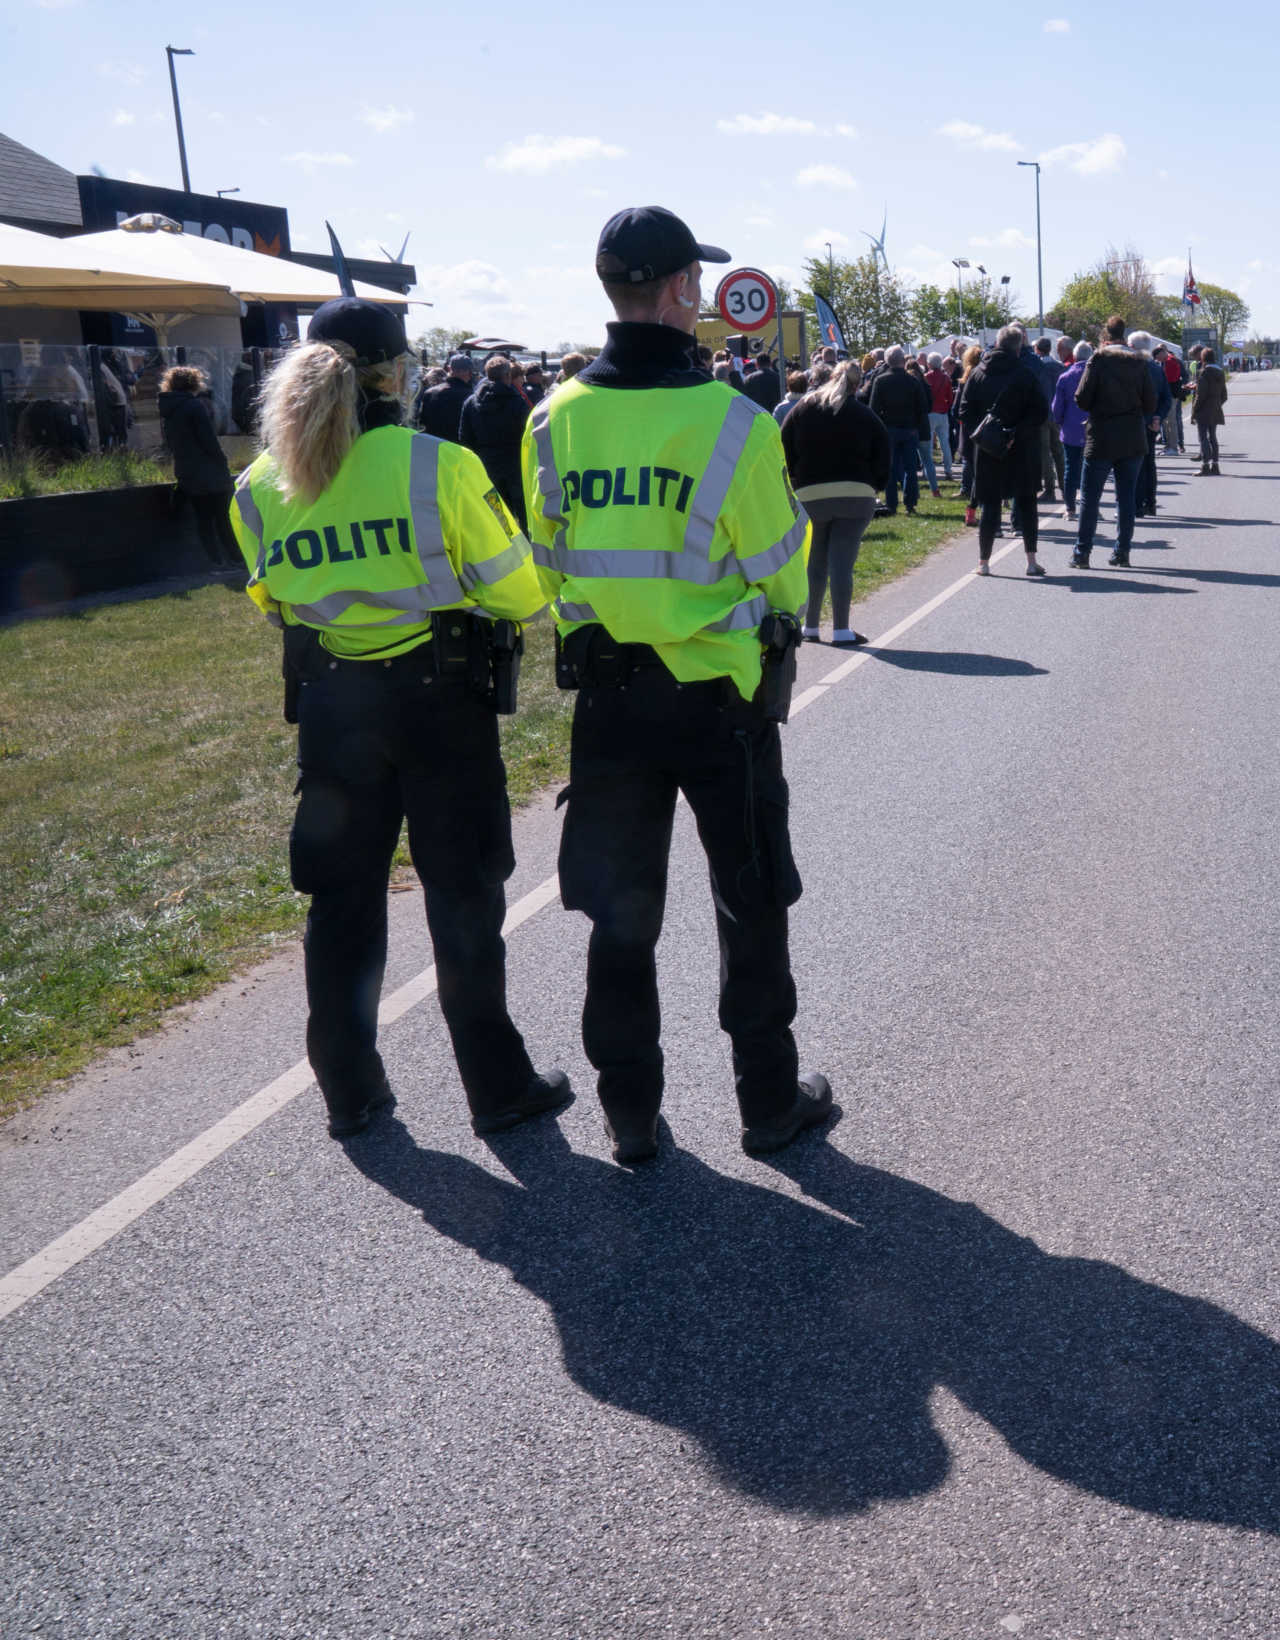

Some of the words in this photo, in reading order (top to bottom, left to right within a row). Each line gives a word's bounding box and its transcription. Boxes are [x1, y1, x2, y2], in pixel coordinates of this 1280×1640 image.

[729, 288, 766, 315] 30
[562, 466, 695, 514] POLITI
[258, 517, 412, 579] POLITI
